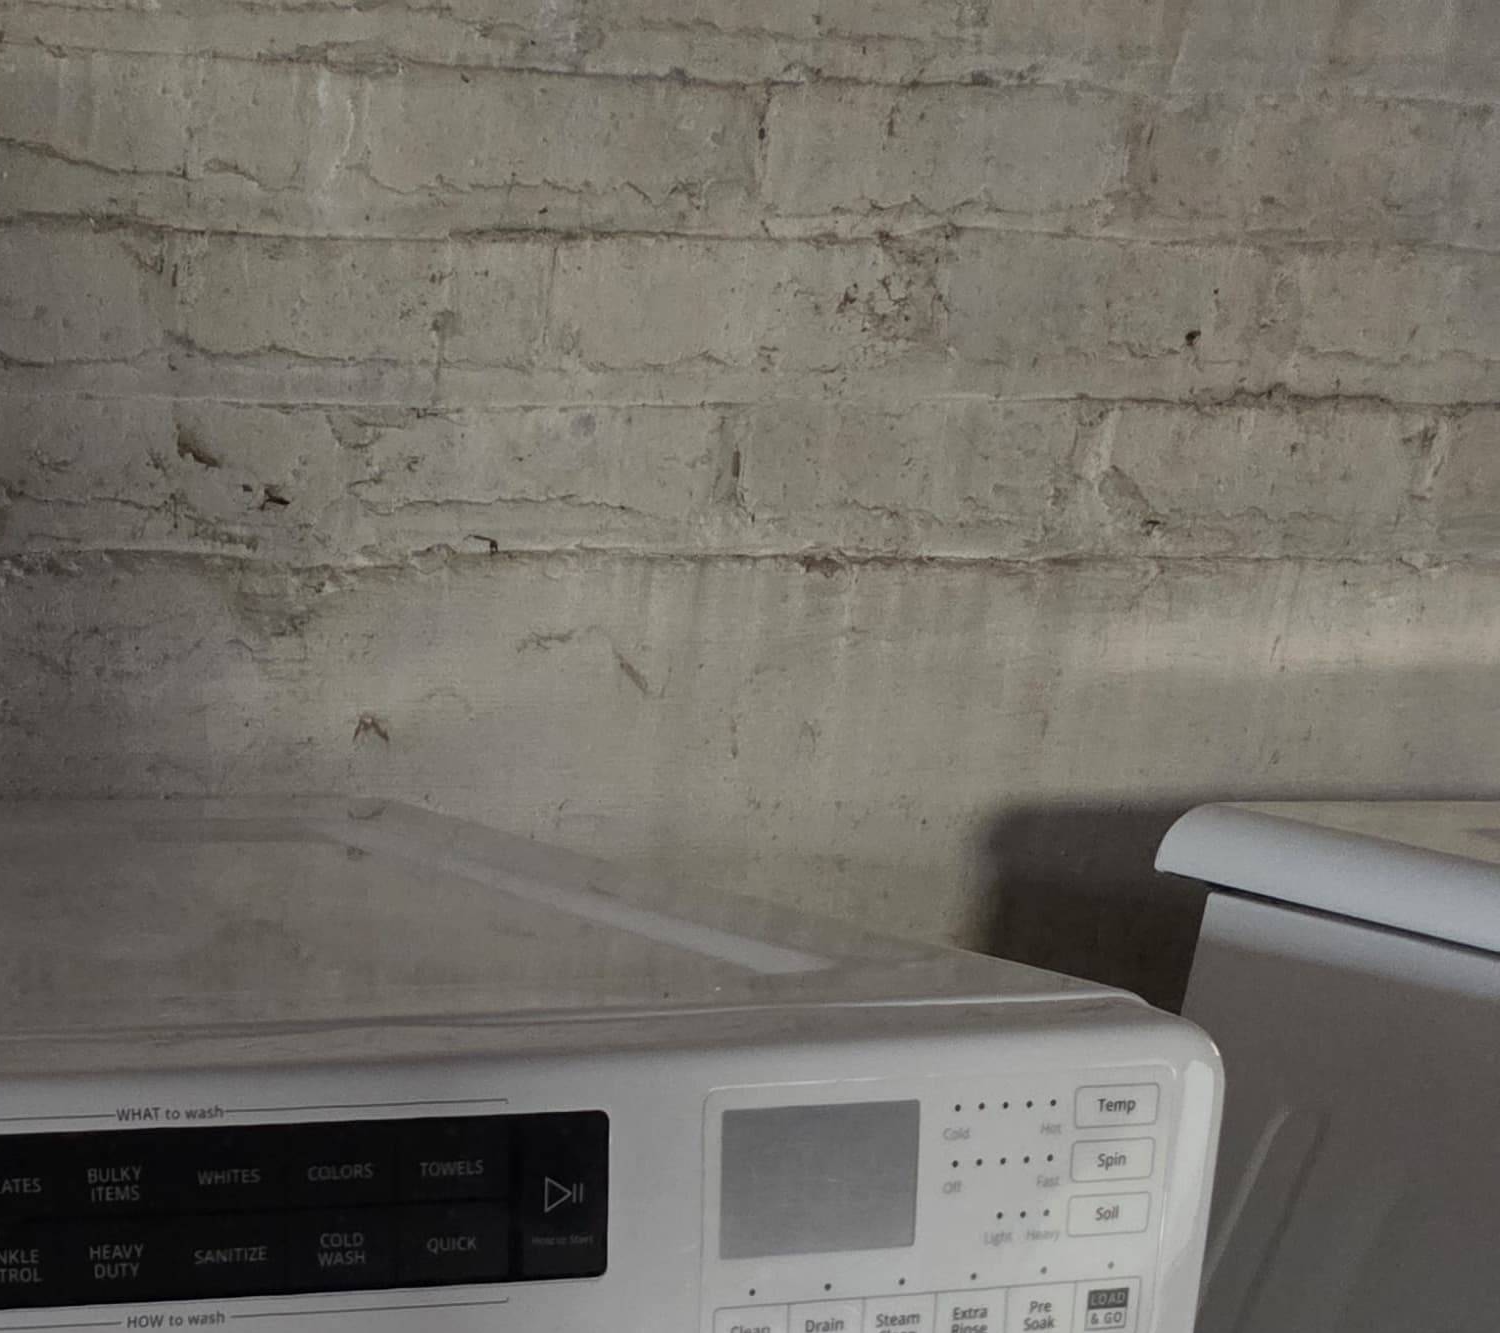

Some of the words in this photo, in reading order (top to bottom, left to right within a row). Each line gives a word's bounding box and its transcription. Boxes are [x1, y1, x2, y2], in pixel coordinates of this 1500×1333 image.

[116, 1106, 161, 1121] WHAT
[165, 1108, 180, 1121] to
[184, 1104, 225, 1120] wash
[1097, 1097, 1136, 1115] Temp
[419, 1160, 484, 1177] TOWELS
[1097, 1151, 1127, 1170] Spin
[87, 1166, 142, 1184] BULKY
[197, 1168, 261, 1185] WHITES
[307, 1163, 374, 1181] COLORS
[91, 1184, 140, 1202] ITEMS
[1095, 1205, 1120, 1221] Soil
[319, 1232, 364, 1248] COLD
[426, 1236, 477, 1254] QUICK
[89, 1244, 144, 1261] HEAVY
[194, 1247, 268, 1265] SANITIZE
[317, 1250, 366, 1267] WASH
[94, 1262, 140, 1279] DUTY
[1029, 1300, 1052, 1314] Pre
[1091, 1290, 1127, 1307] LOAD
[126, 1314, 165, 1328] HOW
[168, 1314, 183, 1327] to
[187, 1310, 226, 1326] wash
[875, 1312, 921, 1328] Steam
[952, 1305, 987, 1321] Extra
[1090, 1313, 1100, 1325] &
[1104, 1311, 1123, 1324] GO
[804, 1317, 844, 1333] Drain
[1023, 1316, 1055, 1332] Soak
